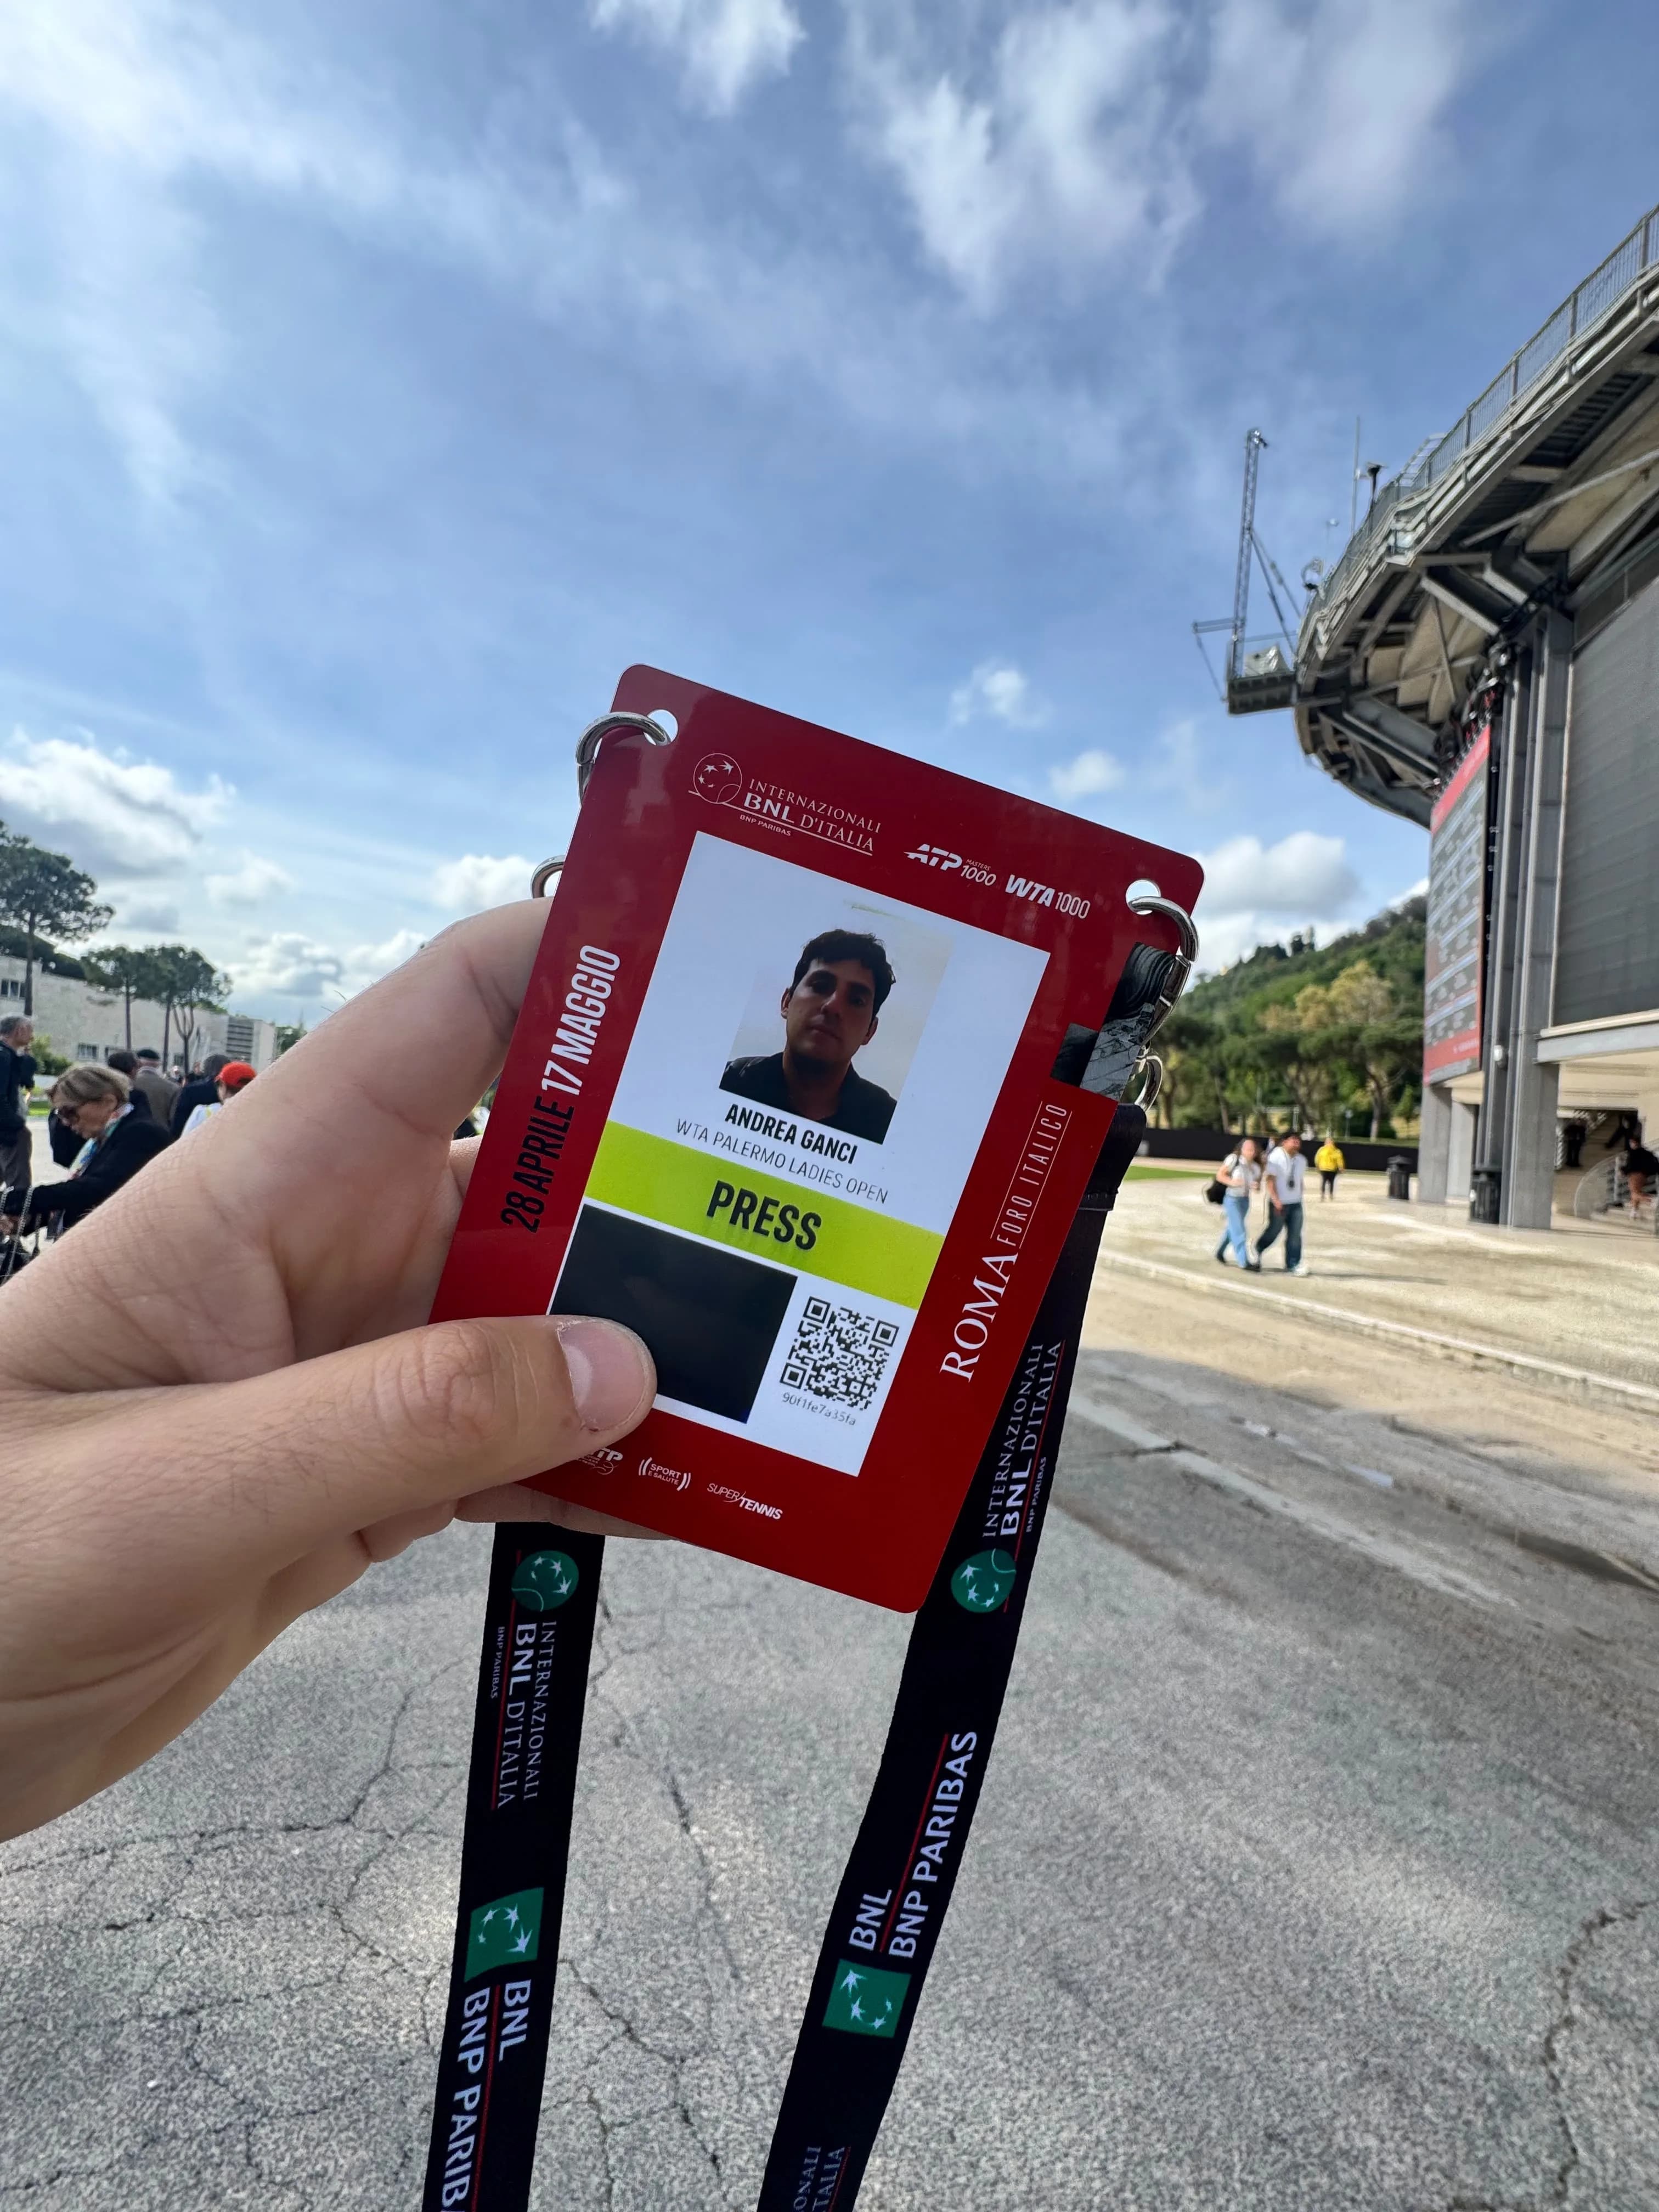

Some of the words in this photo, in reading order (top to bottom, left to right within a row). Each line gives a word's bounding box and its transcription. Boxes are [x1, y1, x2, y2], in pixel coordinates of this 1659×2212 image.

[740, 814, 757, 825] BNP
[758, 821, 791, 836] PARIBAS
[743, 792, 794, 823] BNL
[800, 814, 873, 851] D'ITALIA
[749, 778, 881, 833] INTERNAZIONALI
[904, 844, 962, 871] ATP
[961, 865, 996, 886] 1000
[966, 859, 991, 871] MASTERS
[1005, 874, 1055, 907] WTA
[1055, 892, 1091, 919] 1000
[551, 945, 620, 1065] MAGGIO
[541, 1060, 583, 1096] 17
[512, 1096, 575, 1195] APRILE
[676, 1118, 708, 1143] WTA
[713, 1131, 786, 1168] PALERMO
[789, 1158, 843, 1188] LADIES
[846, 1178, 889, 1204] OPEN
[725, 1104, 797, 1145] ANDREA
[801, 1130, 857, 1164] GANCI
[500, 1191, 545, 1233] 28
[706, 1180, 822, 1250] PRESS
[940, 1252, 1018, 1383] ROMA
[996, 1195, 1032, 1246] FORO
[1019, 1104, 1067, 1186] ITALICO
[597, 1448, 623, 1462] TP
[650, 1463, 681, 1479] SPORT
[983, 1344, 1043, 1537] INTERNAZIONALI
[1000, 1458, 1031, 1536] BNL
[1021, 1342, 1062, 1452] D'ITALIA
[653, 1472, 679, 1485] SALUTE
[1026, 1509, 1035, 1532] BNP
[1031, 1457, 1047, 1505] PARIBAS
[496, 1626, 505, 1650] BNP
[509, 1623, 537, 1696] BNL
[491, 1652, 503, 1699] PARIBAS
[523, 1621, 556, 1800] INTERNAZIONALI
[498, 1701, 525, 1808] D'ITALIA
[889, 1891, 929, 1958] BNP
[912, 1731, 977, 1882] PARIBAS
[849, 1889, 892, 1951] BNL
[458, 1987, 490, 2074] BNP
[499, 1979, 532, 2063] BNL
[440, 2084, 482, 2212] PARIB
[794, 2146, 821, 2212] ONALI
[812, 2146, 845, 2212] TALIA
